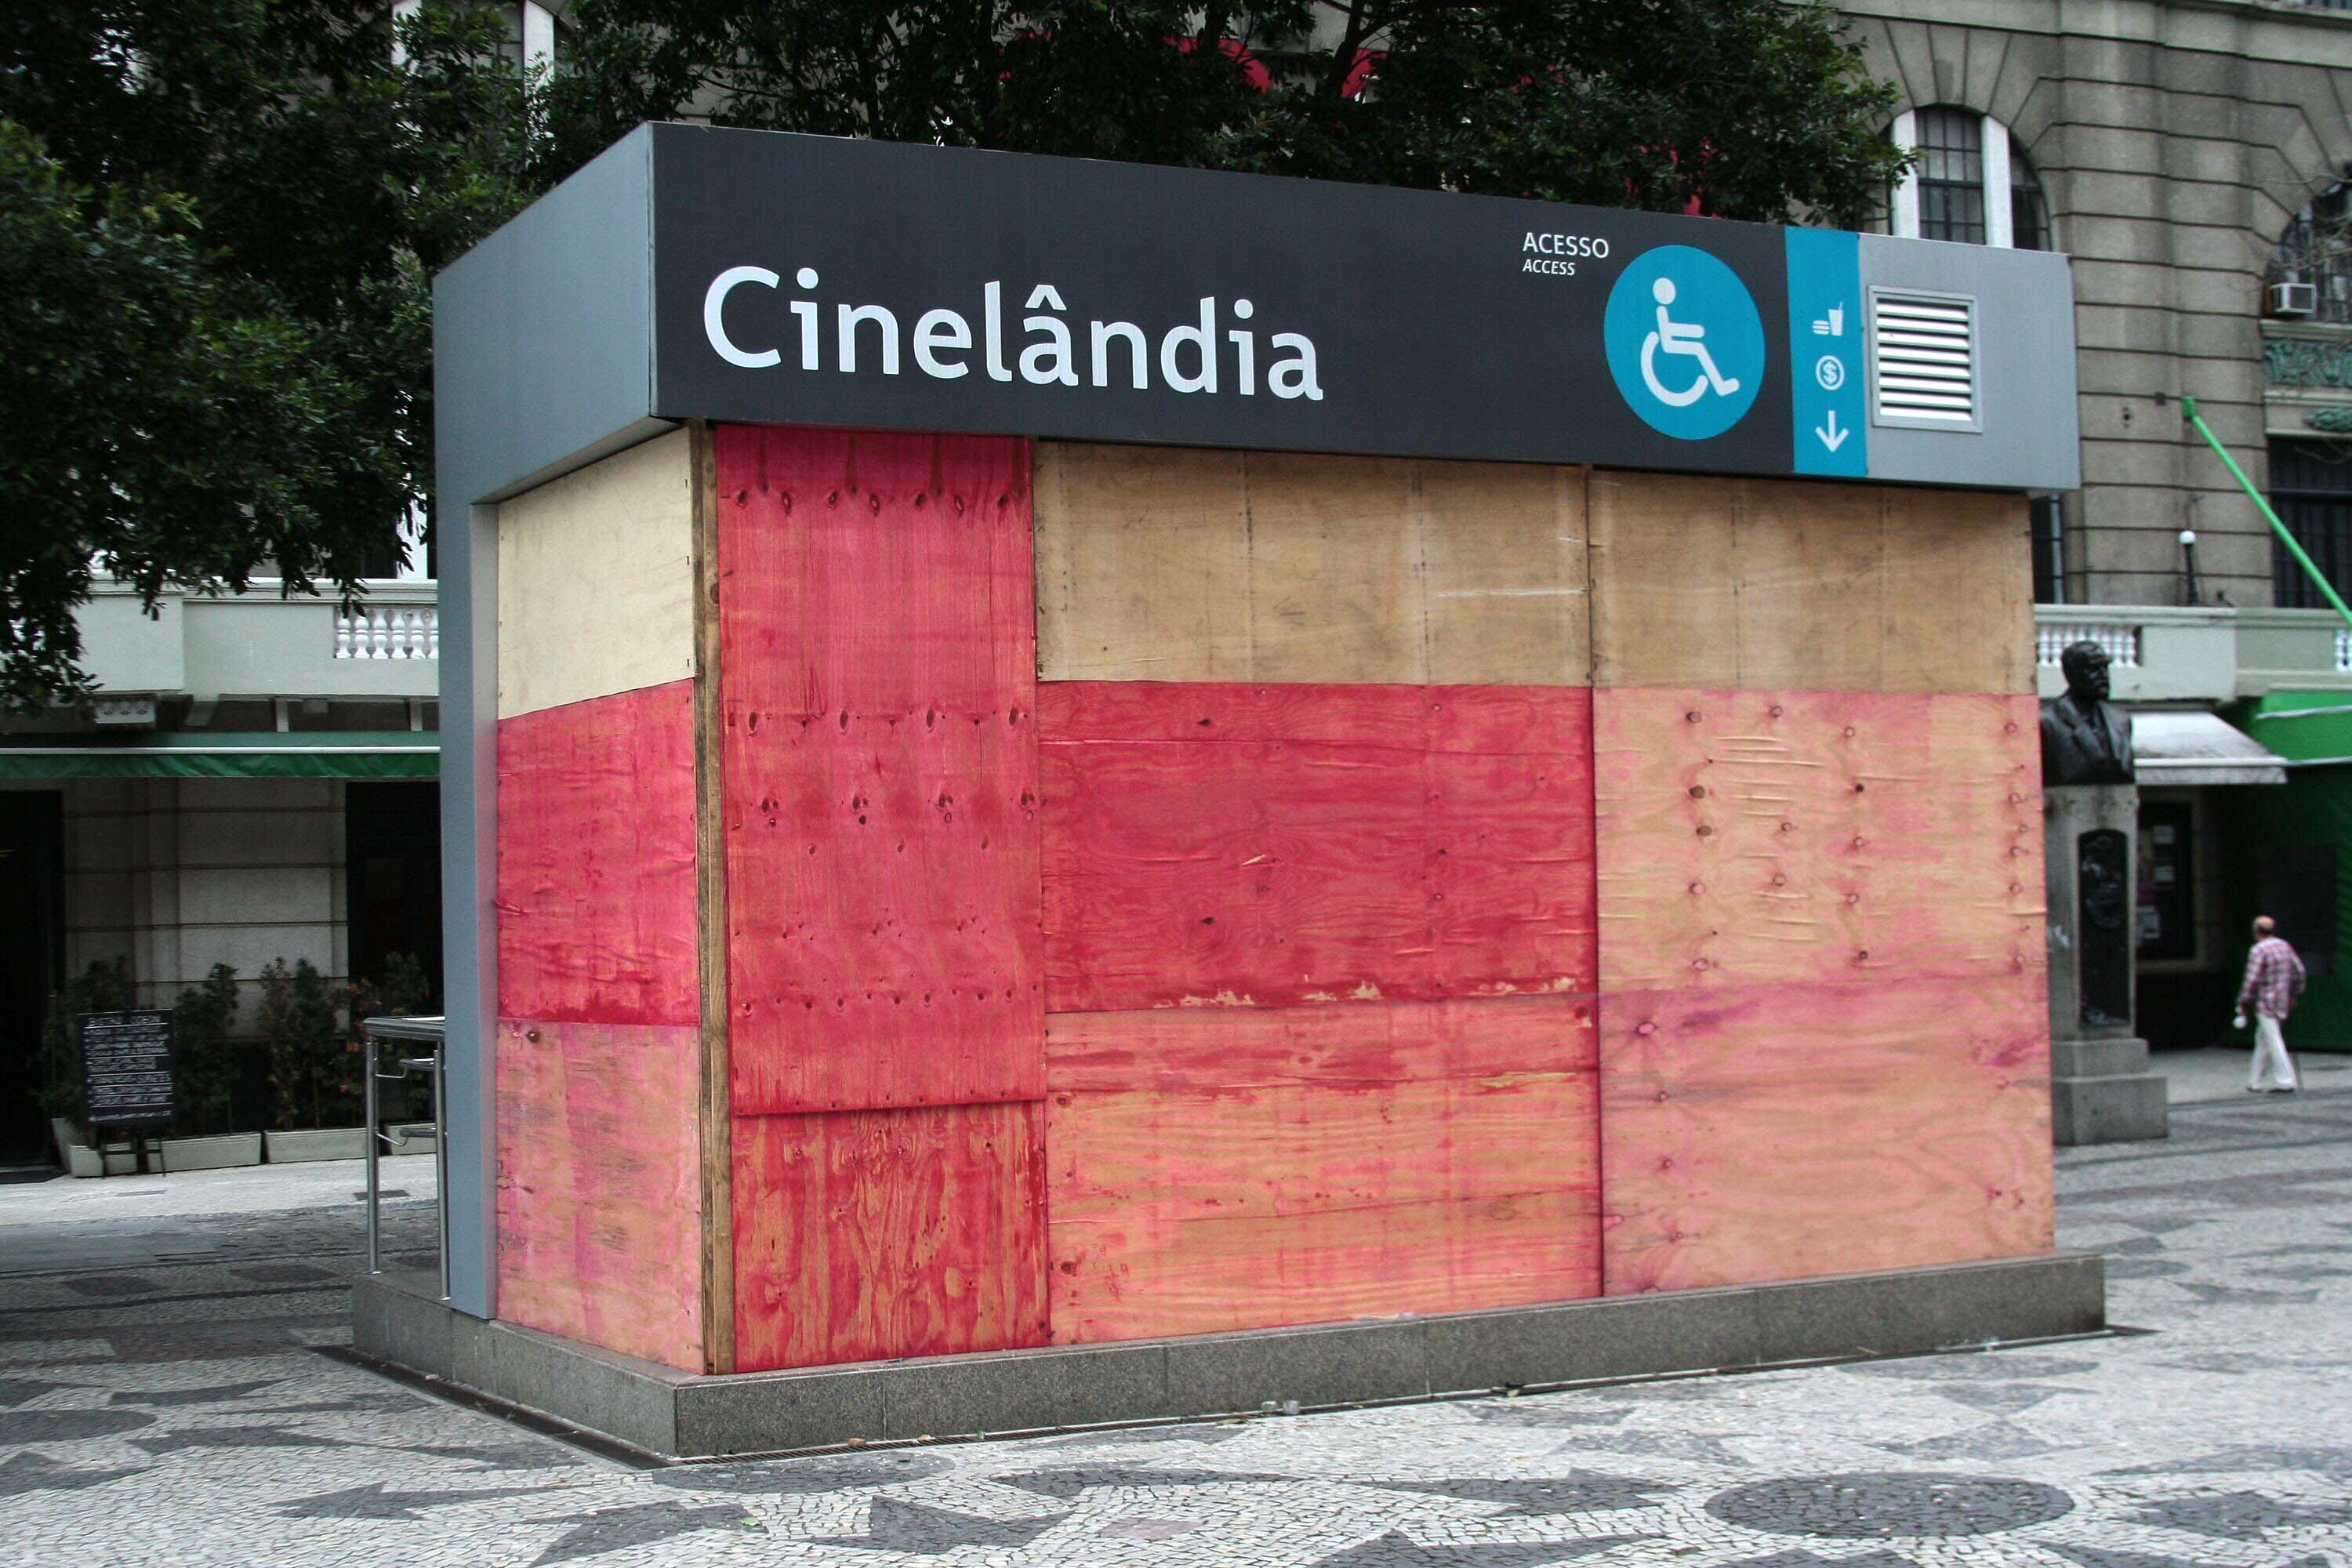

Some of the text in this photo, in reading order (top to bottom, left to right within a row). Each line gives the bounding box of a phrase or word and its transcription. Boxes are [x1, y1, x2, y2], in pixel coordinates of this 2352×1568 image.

[1523, 232, 1609, 258] ACESSO
[1523, 259, 1575, 276] ACCESS
[704, 266, 1323, 401] Cinelândia
